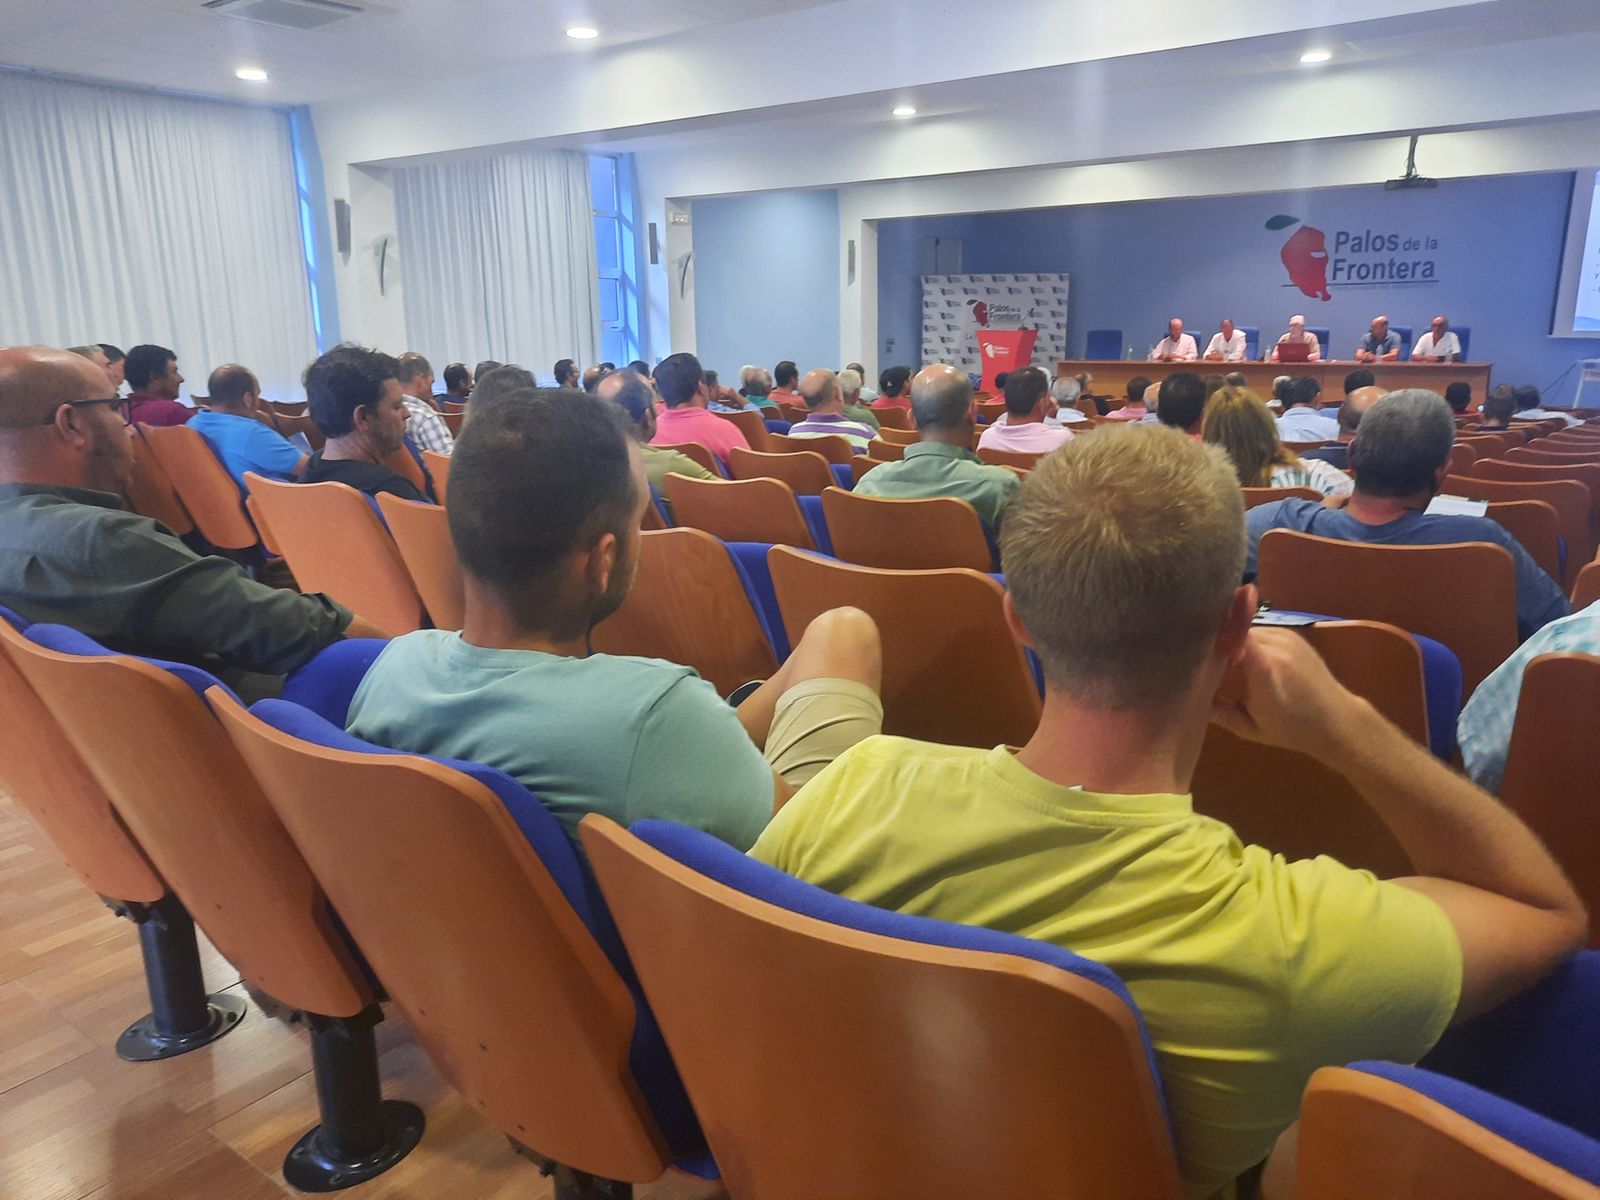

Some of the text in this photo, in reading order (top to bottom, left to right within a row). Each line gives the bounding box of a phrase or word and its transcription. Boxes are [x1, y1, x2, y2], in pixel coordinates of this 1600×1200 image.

[1334, 229, 1438, 254] Palos de la
[1332, 257, 1435, 281] Frontera
